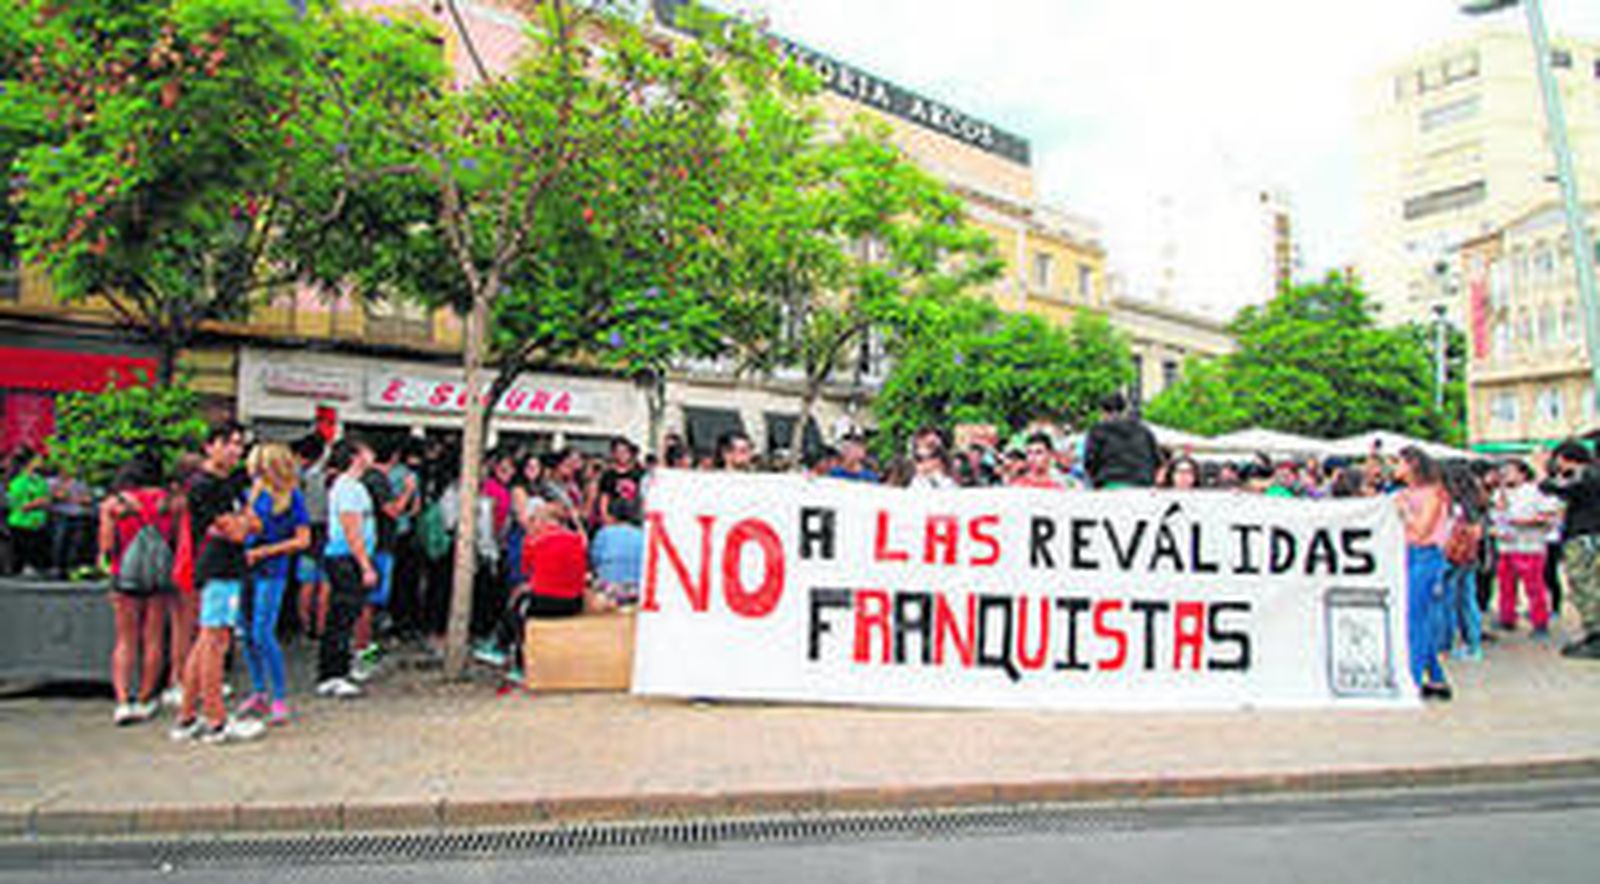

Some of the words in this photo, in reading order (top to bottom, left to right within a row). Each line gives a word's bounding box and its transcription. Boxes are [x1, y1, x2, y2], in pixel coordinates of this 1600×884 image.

[642, 510, 785, 618] NO
[800, 507, 836, 559] A
[874, 510, 1001, 566] LAS
[1029, 502, 1376, 575] REVÁLIDAS
[807, 587, 1251, 682] FRANQUISTAS
